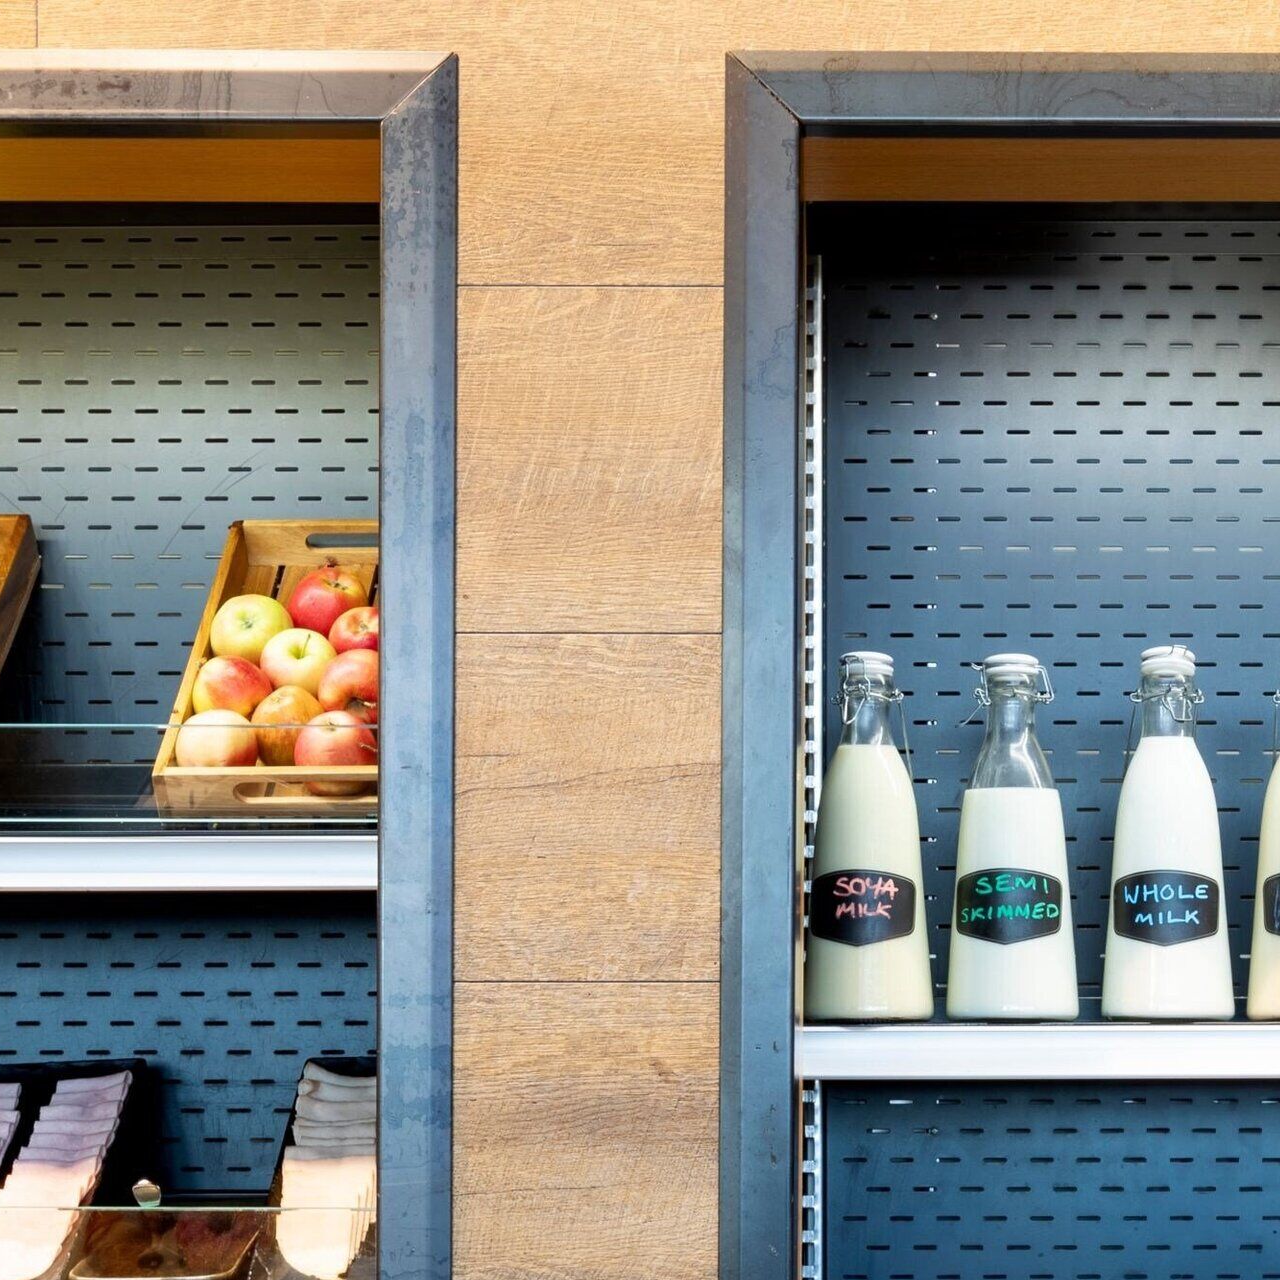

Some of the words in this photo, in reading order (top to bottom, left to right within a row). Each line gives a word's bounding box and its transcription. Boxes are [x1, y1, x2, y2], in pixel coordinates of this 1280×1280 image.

[833, 877, 899, 900] SOYA
[975, 874, 1049, 894] SEMI
[1124, 884, 1209, 904] WHOLE
[835, 902, 892, 919] MILK
[960, 902, 1059, 923] SKIMMED
[1135, 910, 1200, 926] MILK
